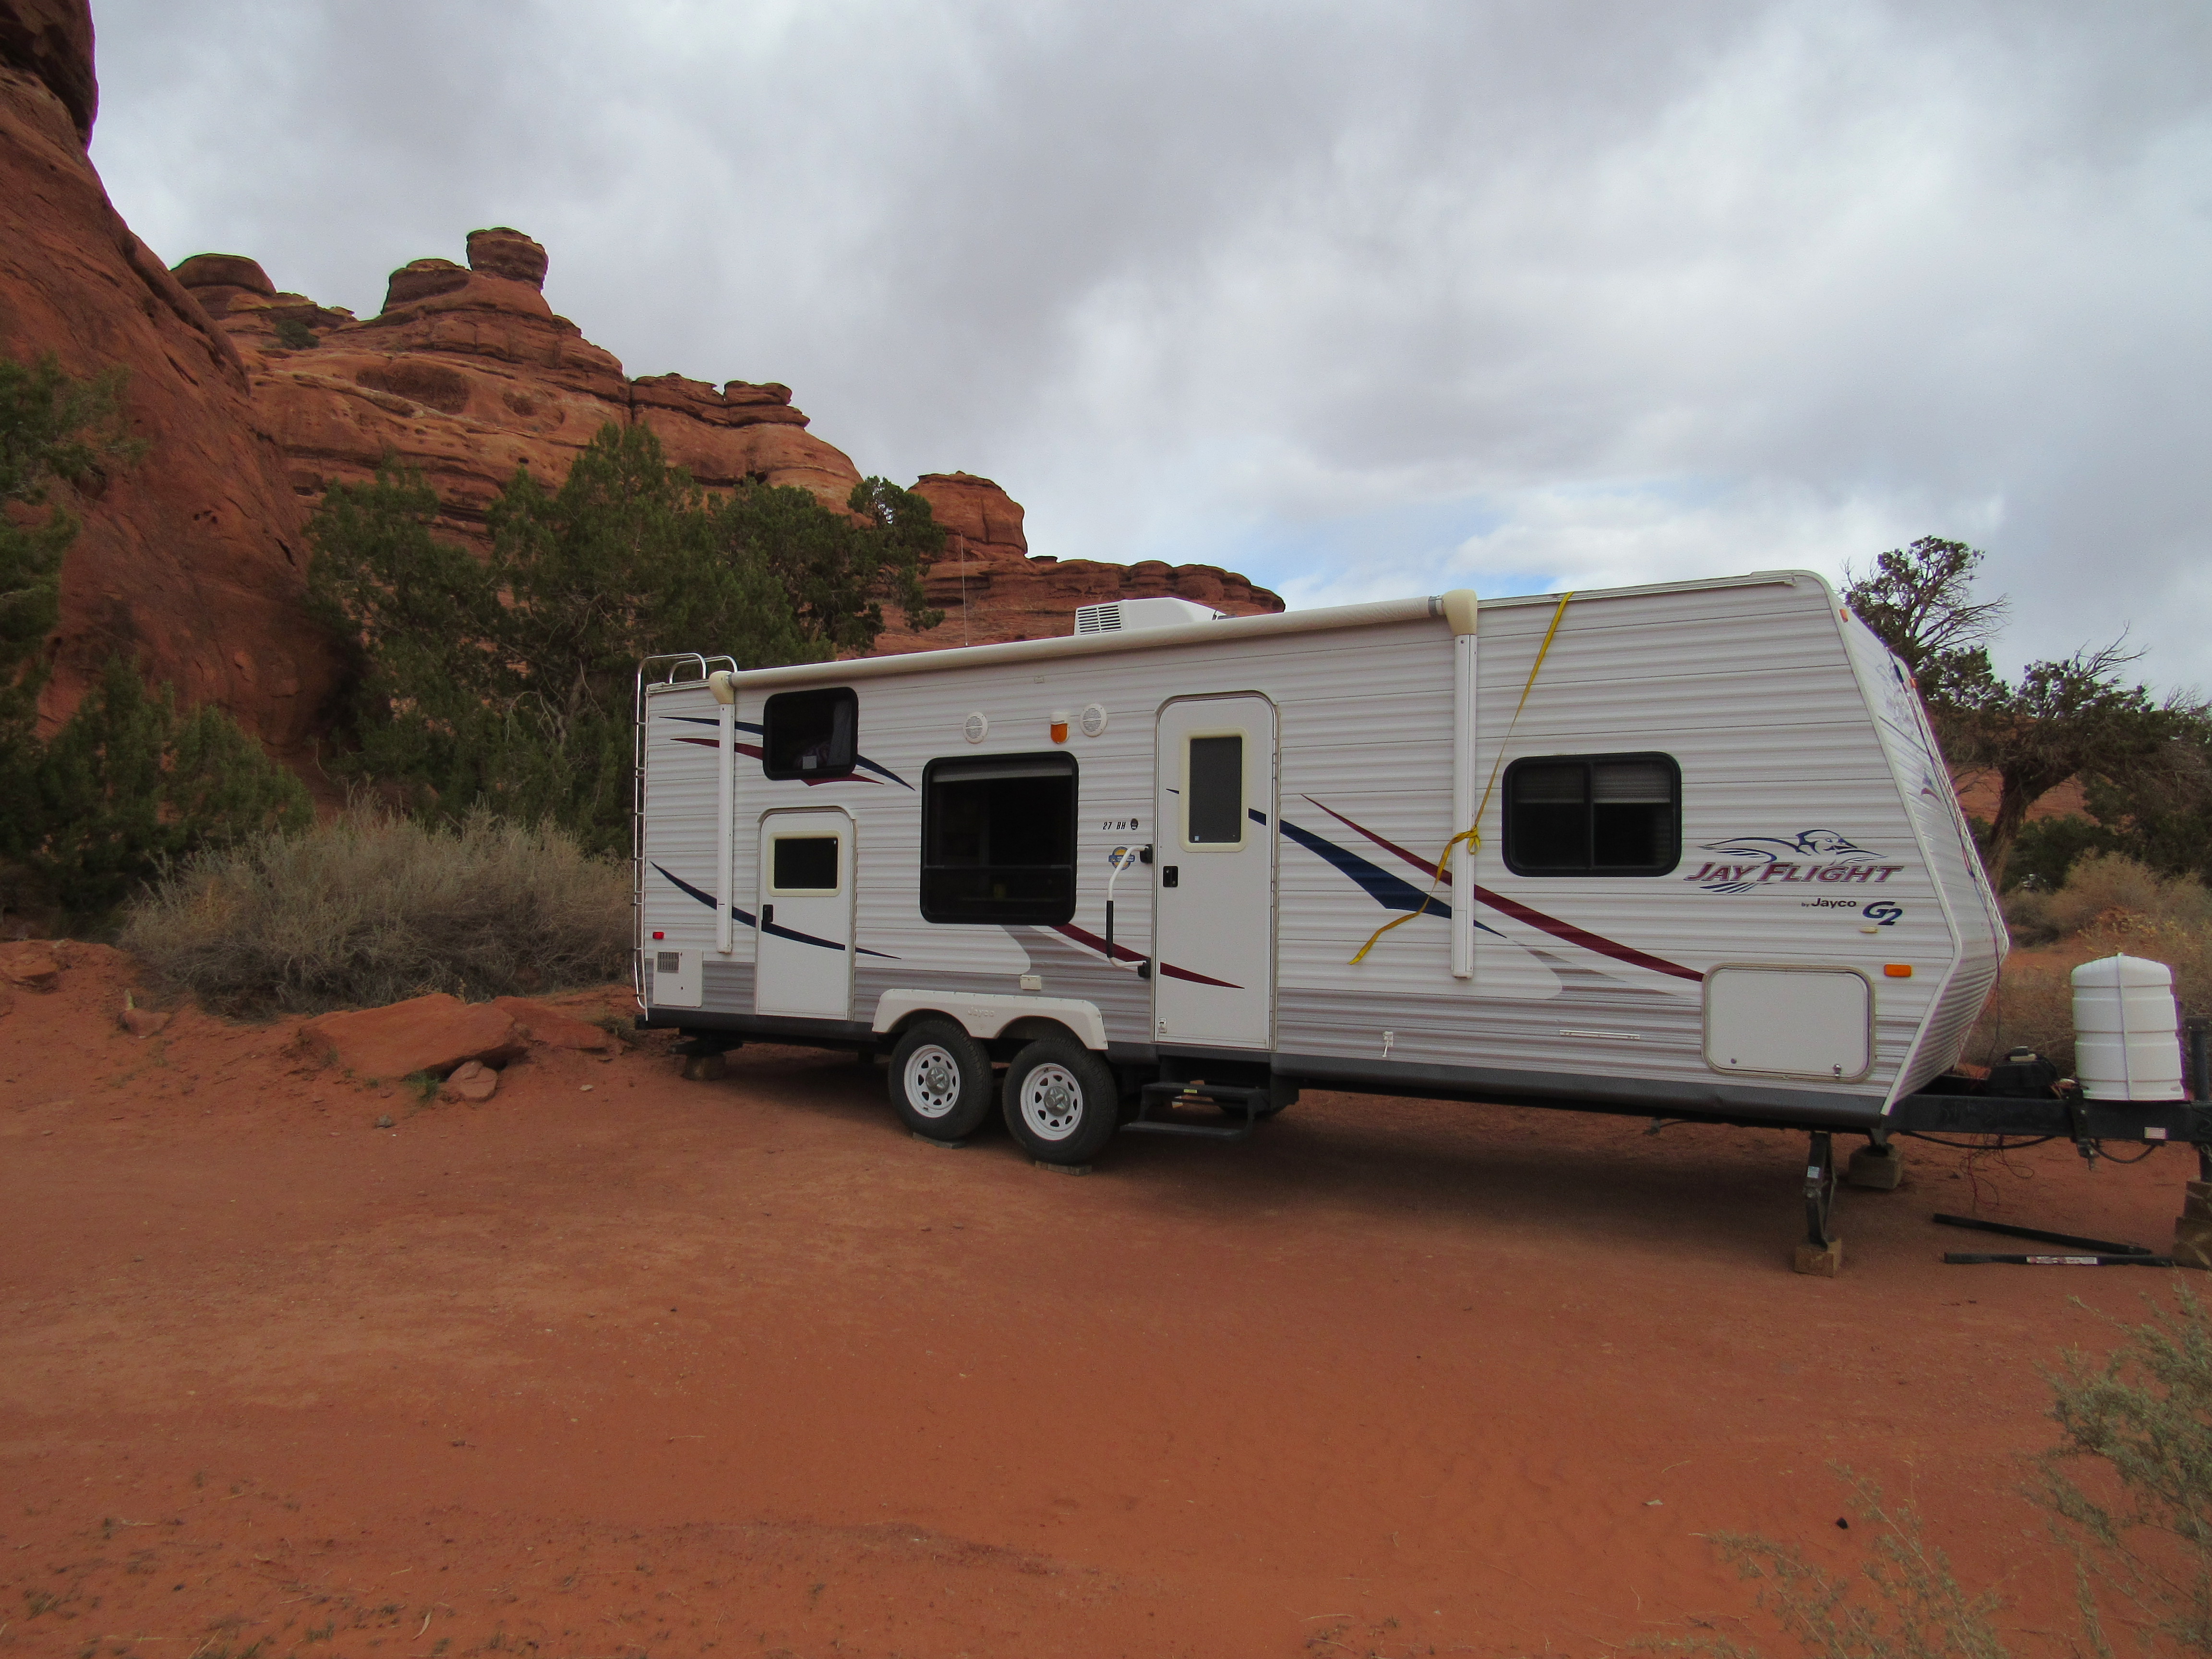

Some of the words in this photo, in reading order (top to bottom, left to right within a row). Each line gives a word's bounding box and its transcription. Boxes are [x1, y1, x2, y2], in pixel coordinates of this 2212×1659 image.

[1117, 821, 1126, 830] BH
[1683, 862, 1760, 882] JAY
[1757, 862, 1904, 883] FLIGHT
[1811, 898, 1856, 909] Jayco
[1863, 901, 1903, 926] G2
